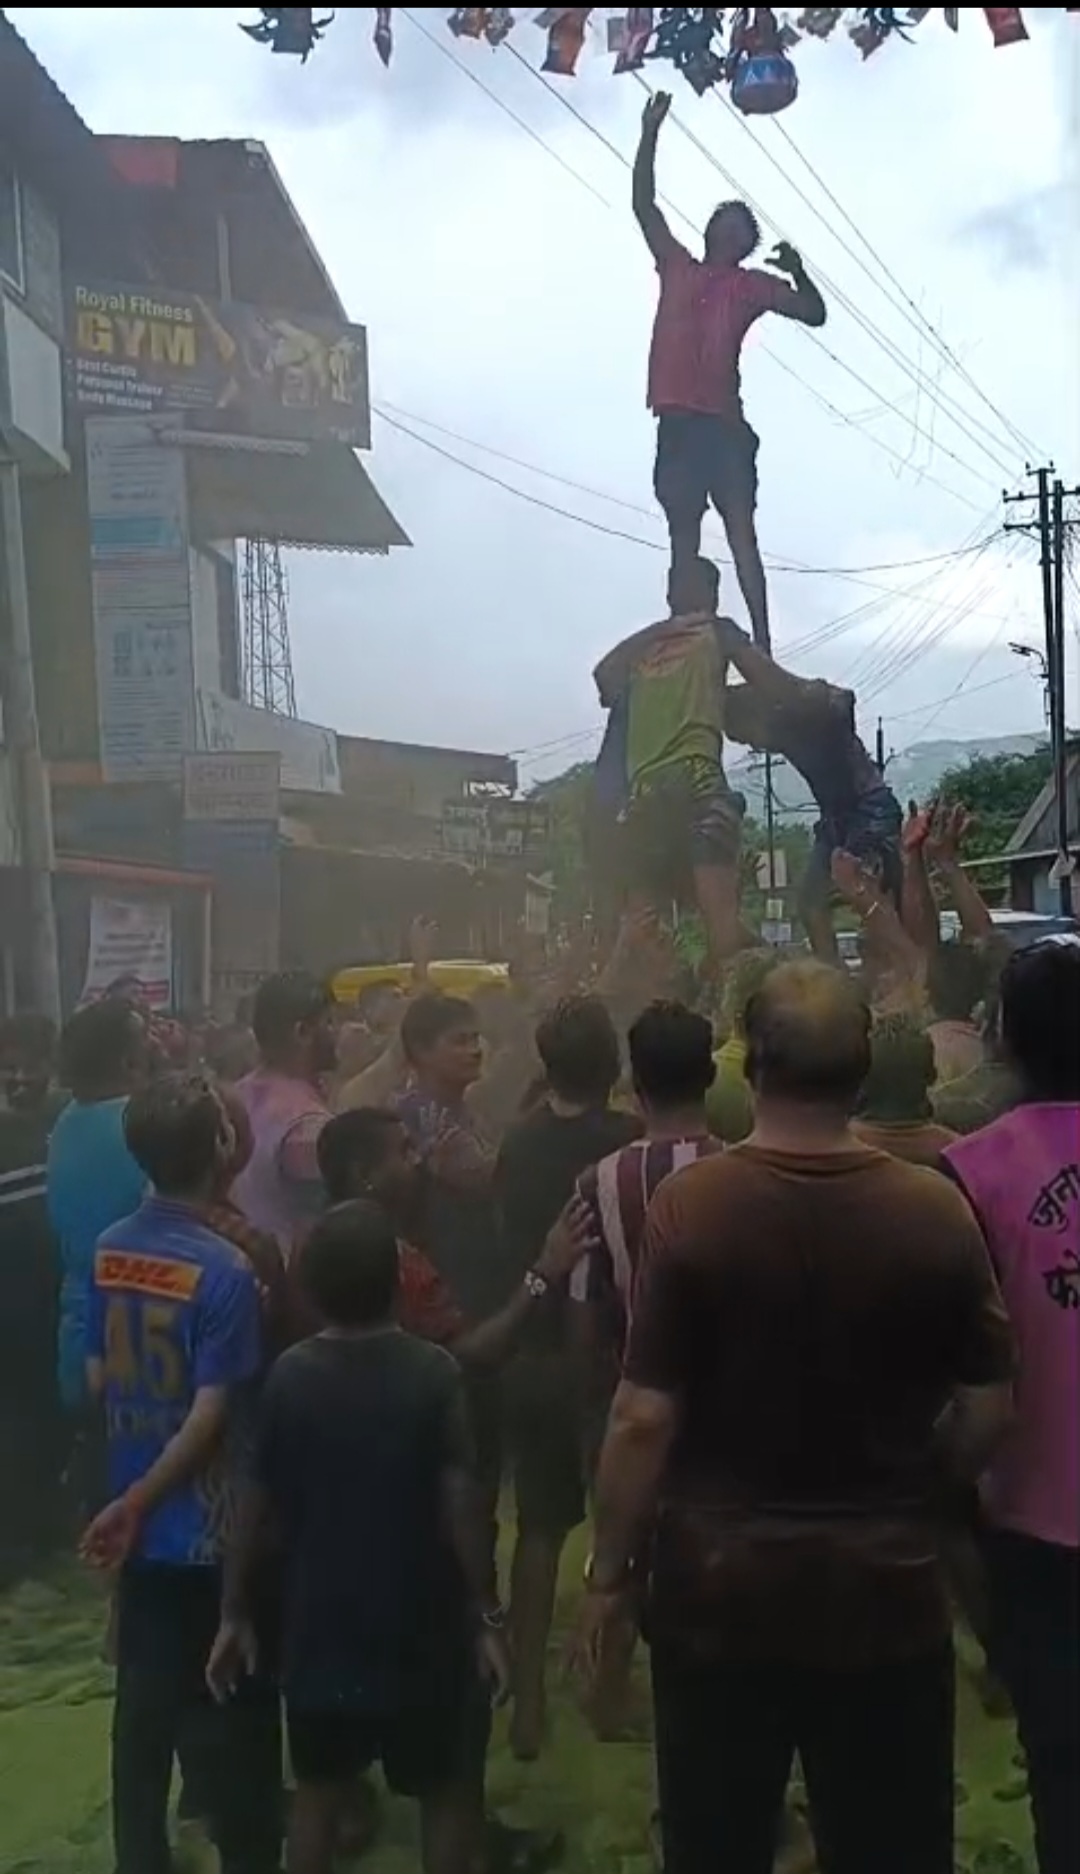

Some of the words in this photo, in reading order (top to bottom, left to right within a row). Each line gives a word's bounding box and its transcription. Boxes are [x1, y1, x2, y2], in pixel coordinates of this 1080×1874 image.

[75, 285, 125, 312] Royal
[129, 296, 194, 322] Fitness
[76, 311, 197, 367] GYM
[102, 1299, 182, 1400] 45
